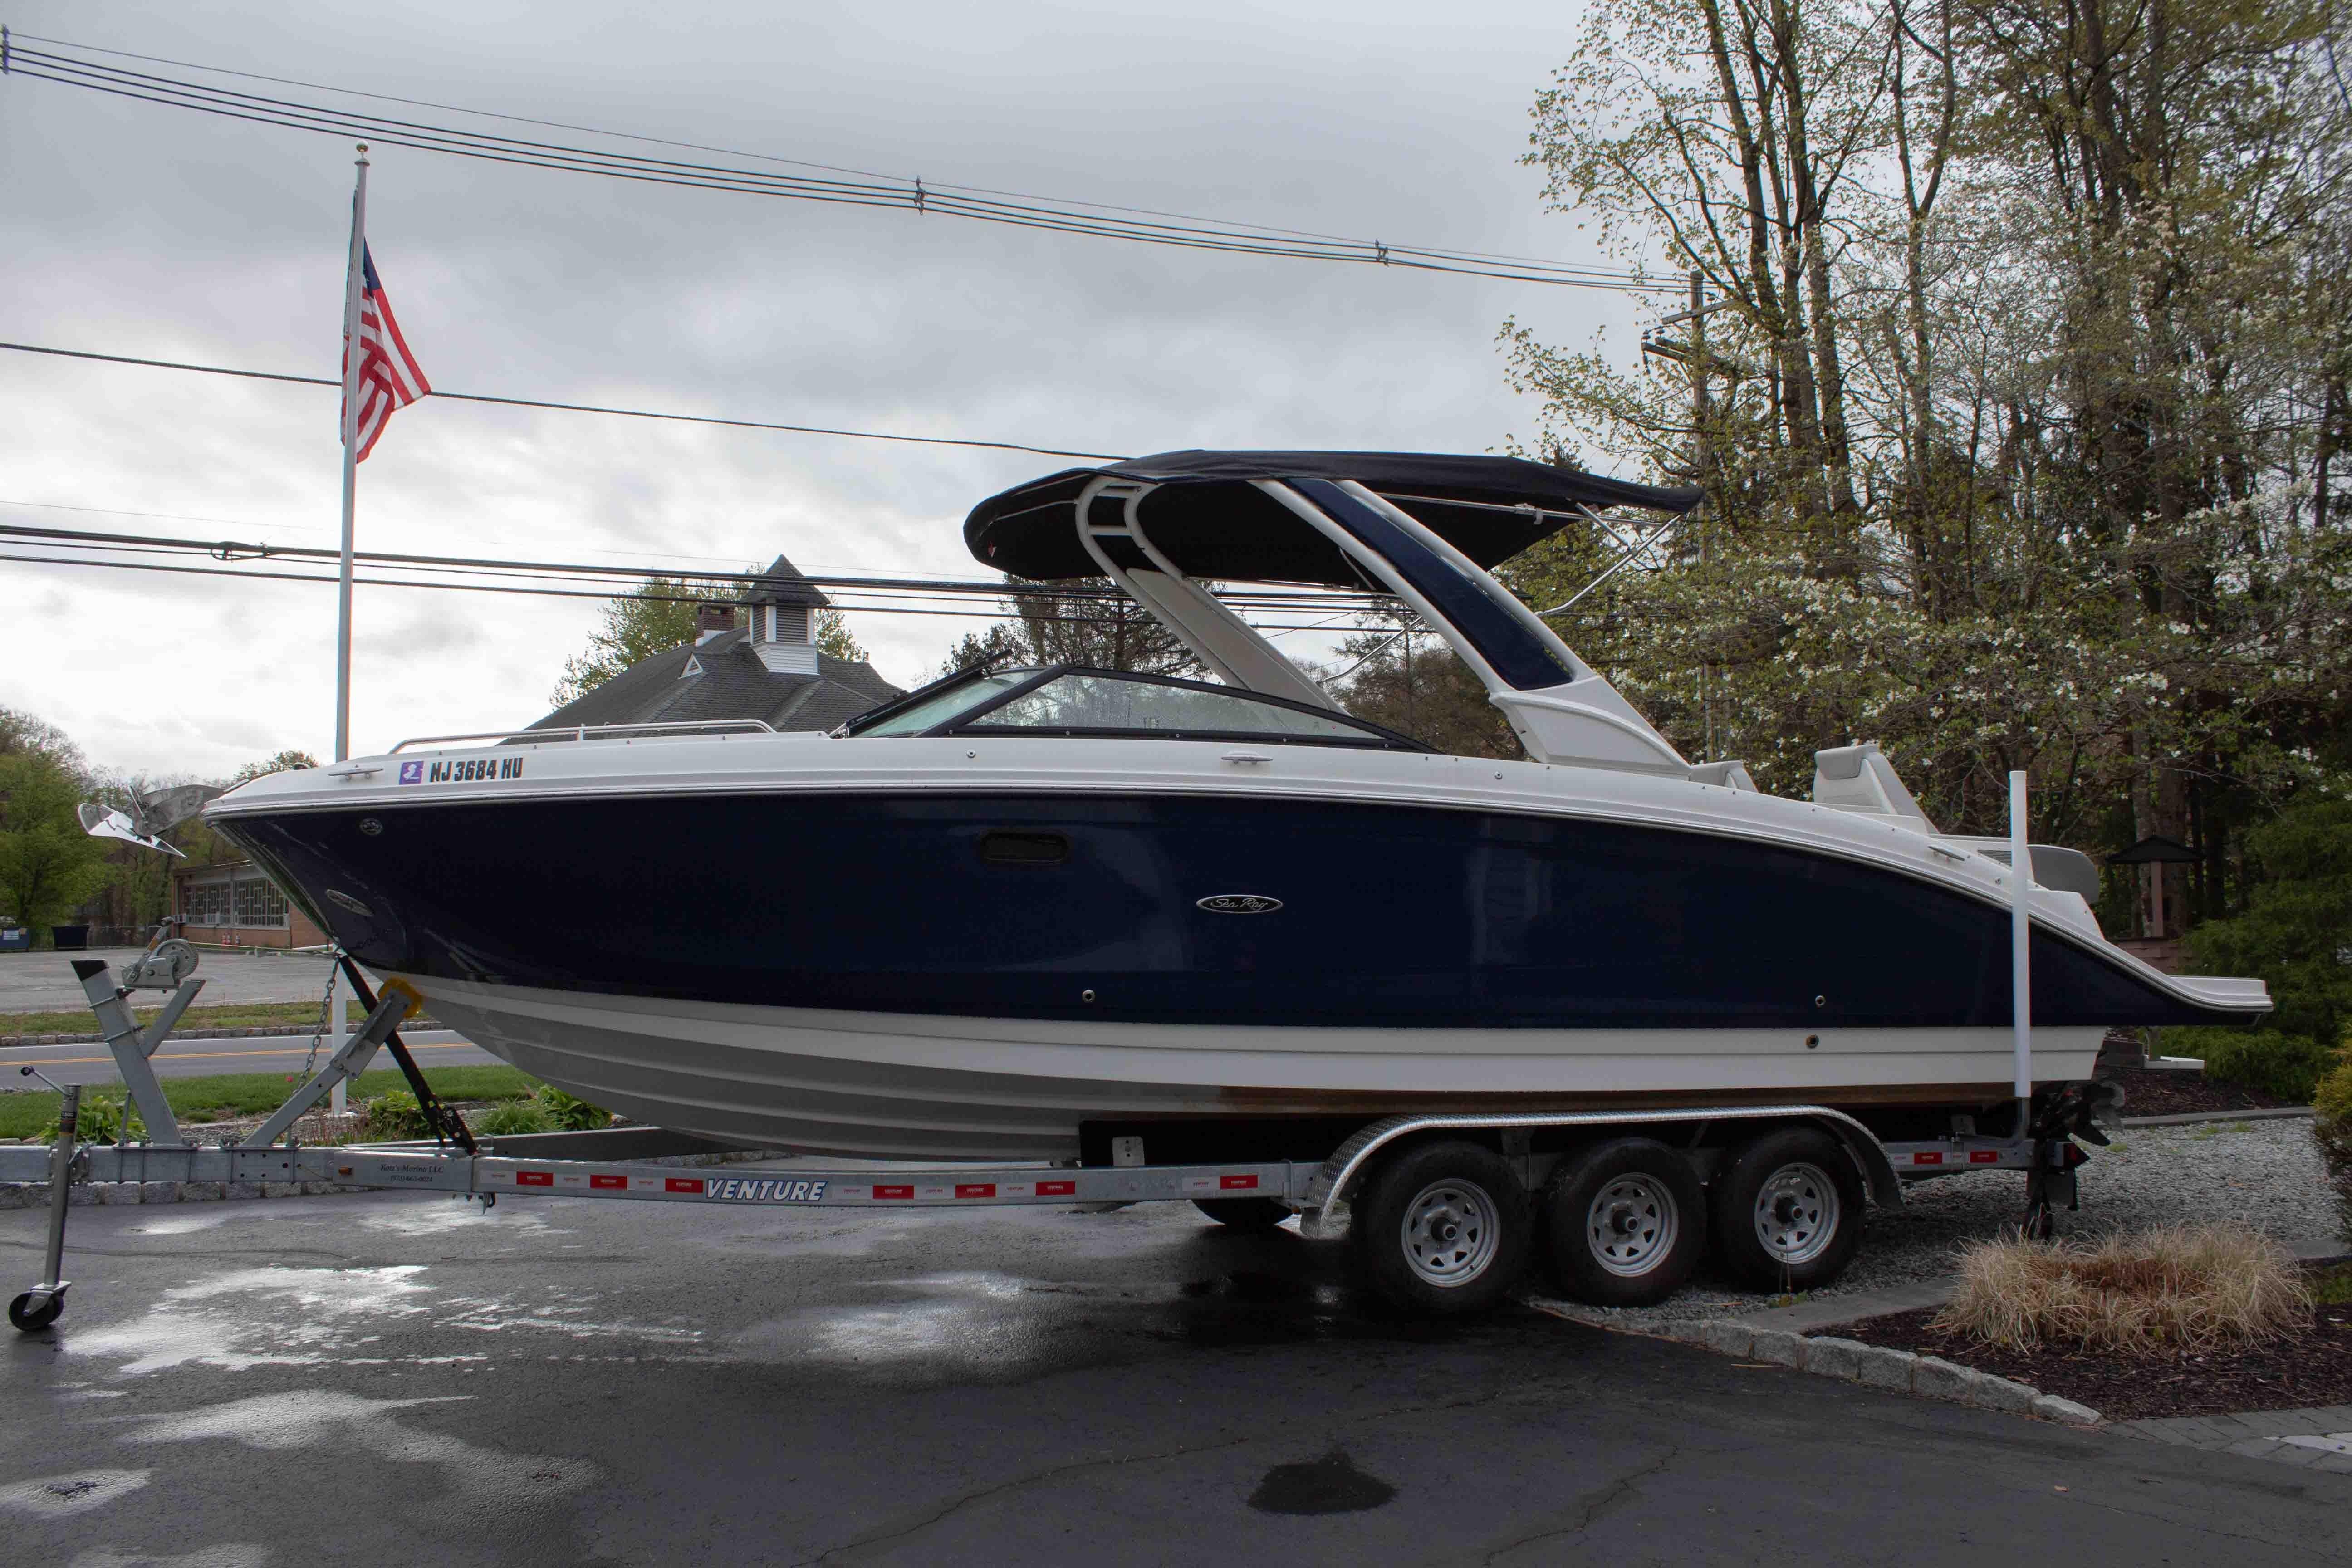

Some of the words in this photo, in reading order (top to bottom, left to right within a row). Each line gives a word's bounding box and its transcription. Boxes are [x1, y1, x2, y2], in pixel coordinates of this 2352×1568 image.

[430, 761, 453, 783] NJ
[454, 760, 497, 782] 3684
[501, 757, 523, 779] HU
[1210, 898, 1238, 908] Sea
[1240, 898, 1268, 911] Ray
[402, 1164, 426, 1172] Marina
[707, 1179, 828, 1201] VENTURE
